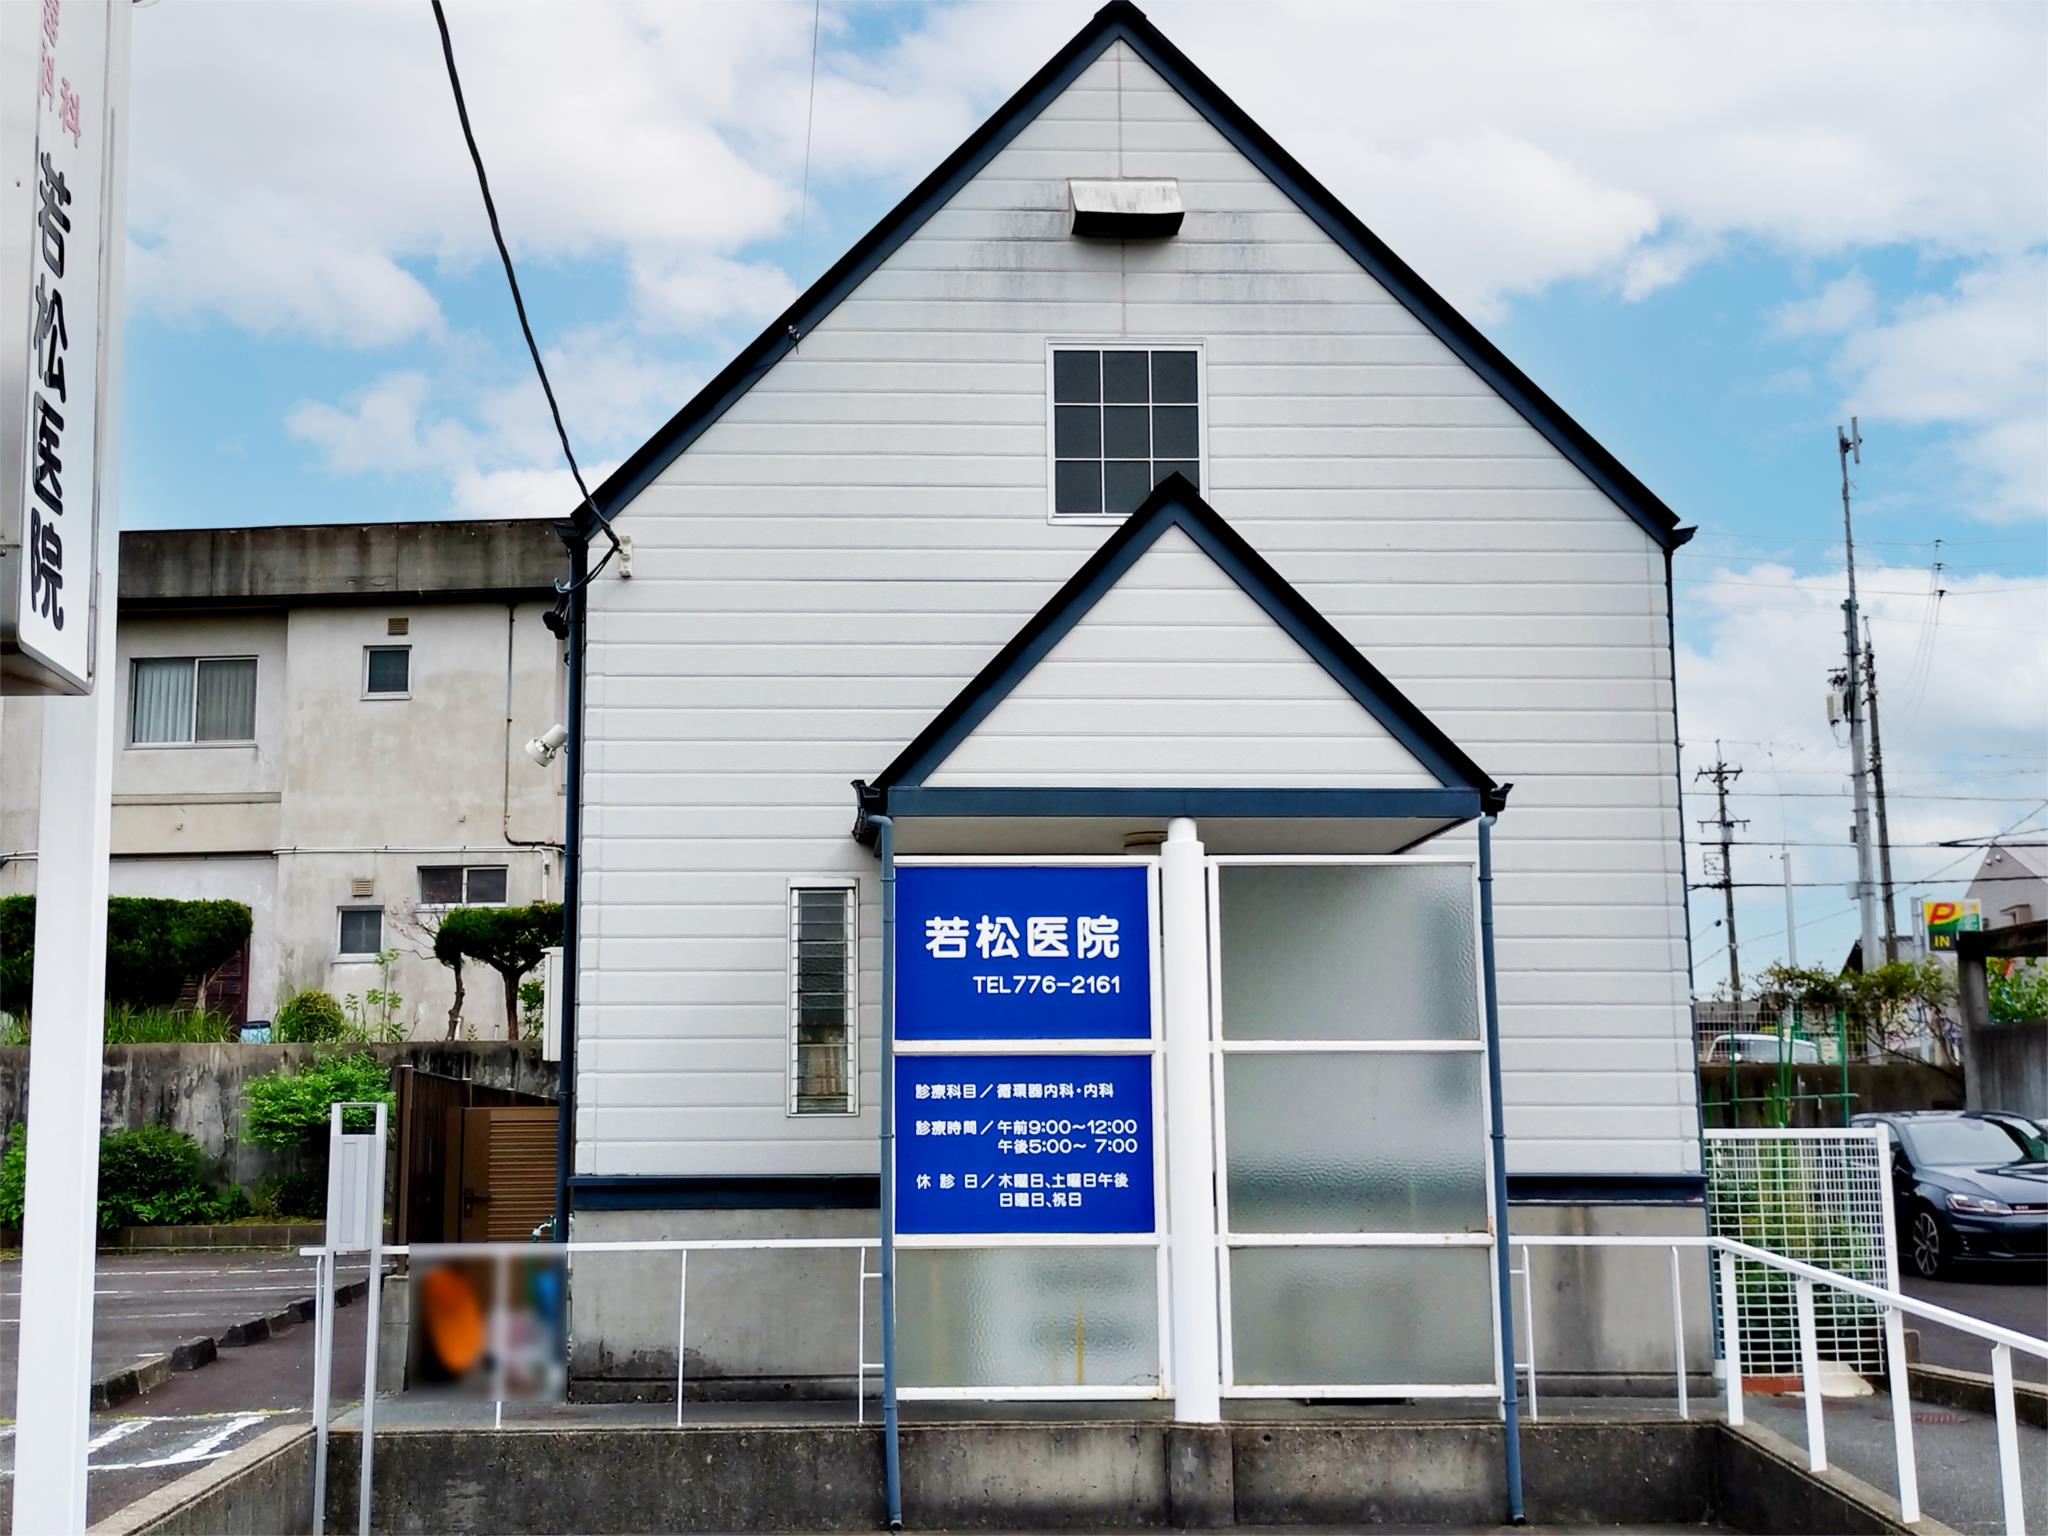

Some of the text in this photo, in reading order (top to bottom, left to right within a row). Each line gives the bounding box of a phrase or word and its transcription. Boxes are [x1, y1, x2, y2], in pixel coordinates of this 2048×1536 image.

[31, 152, 72, 631] 若松医院
[1927, 902, 1956, 925] P
[925, 914, 1120, 959] 若松医院
[1934, 935, 1950, 948] IN
[973, 975, 1120, 994] TEL776-2161
[999, 1192, 1082, 1208] 日曜日、祝日
